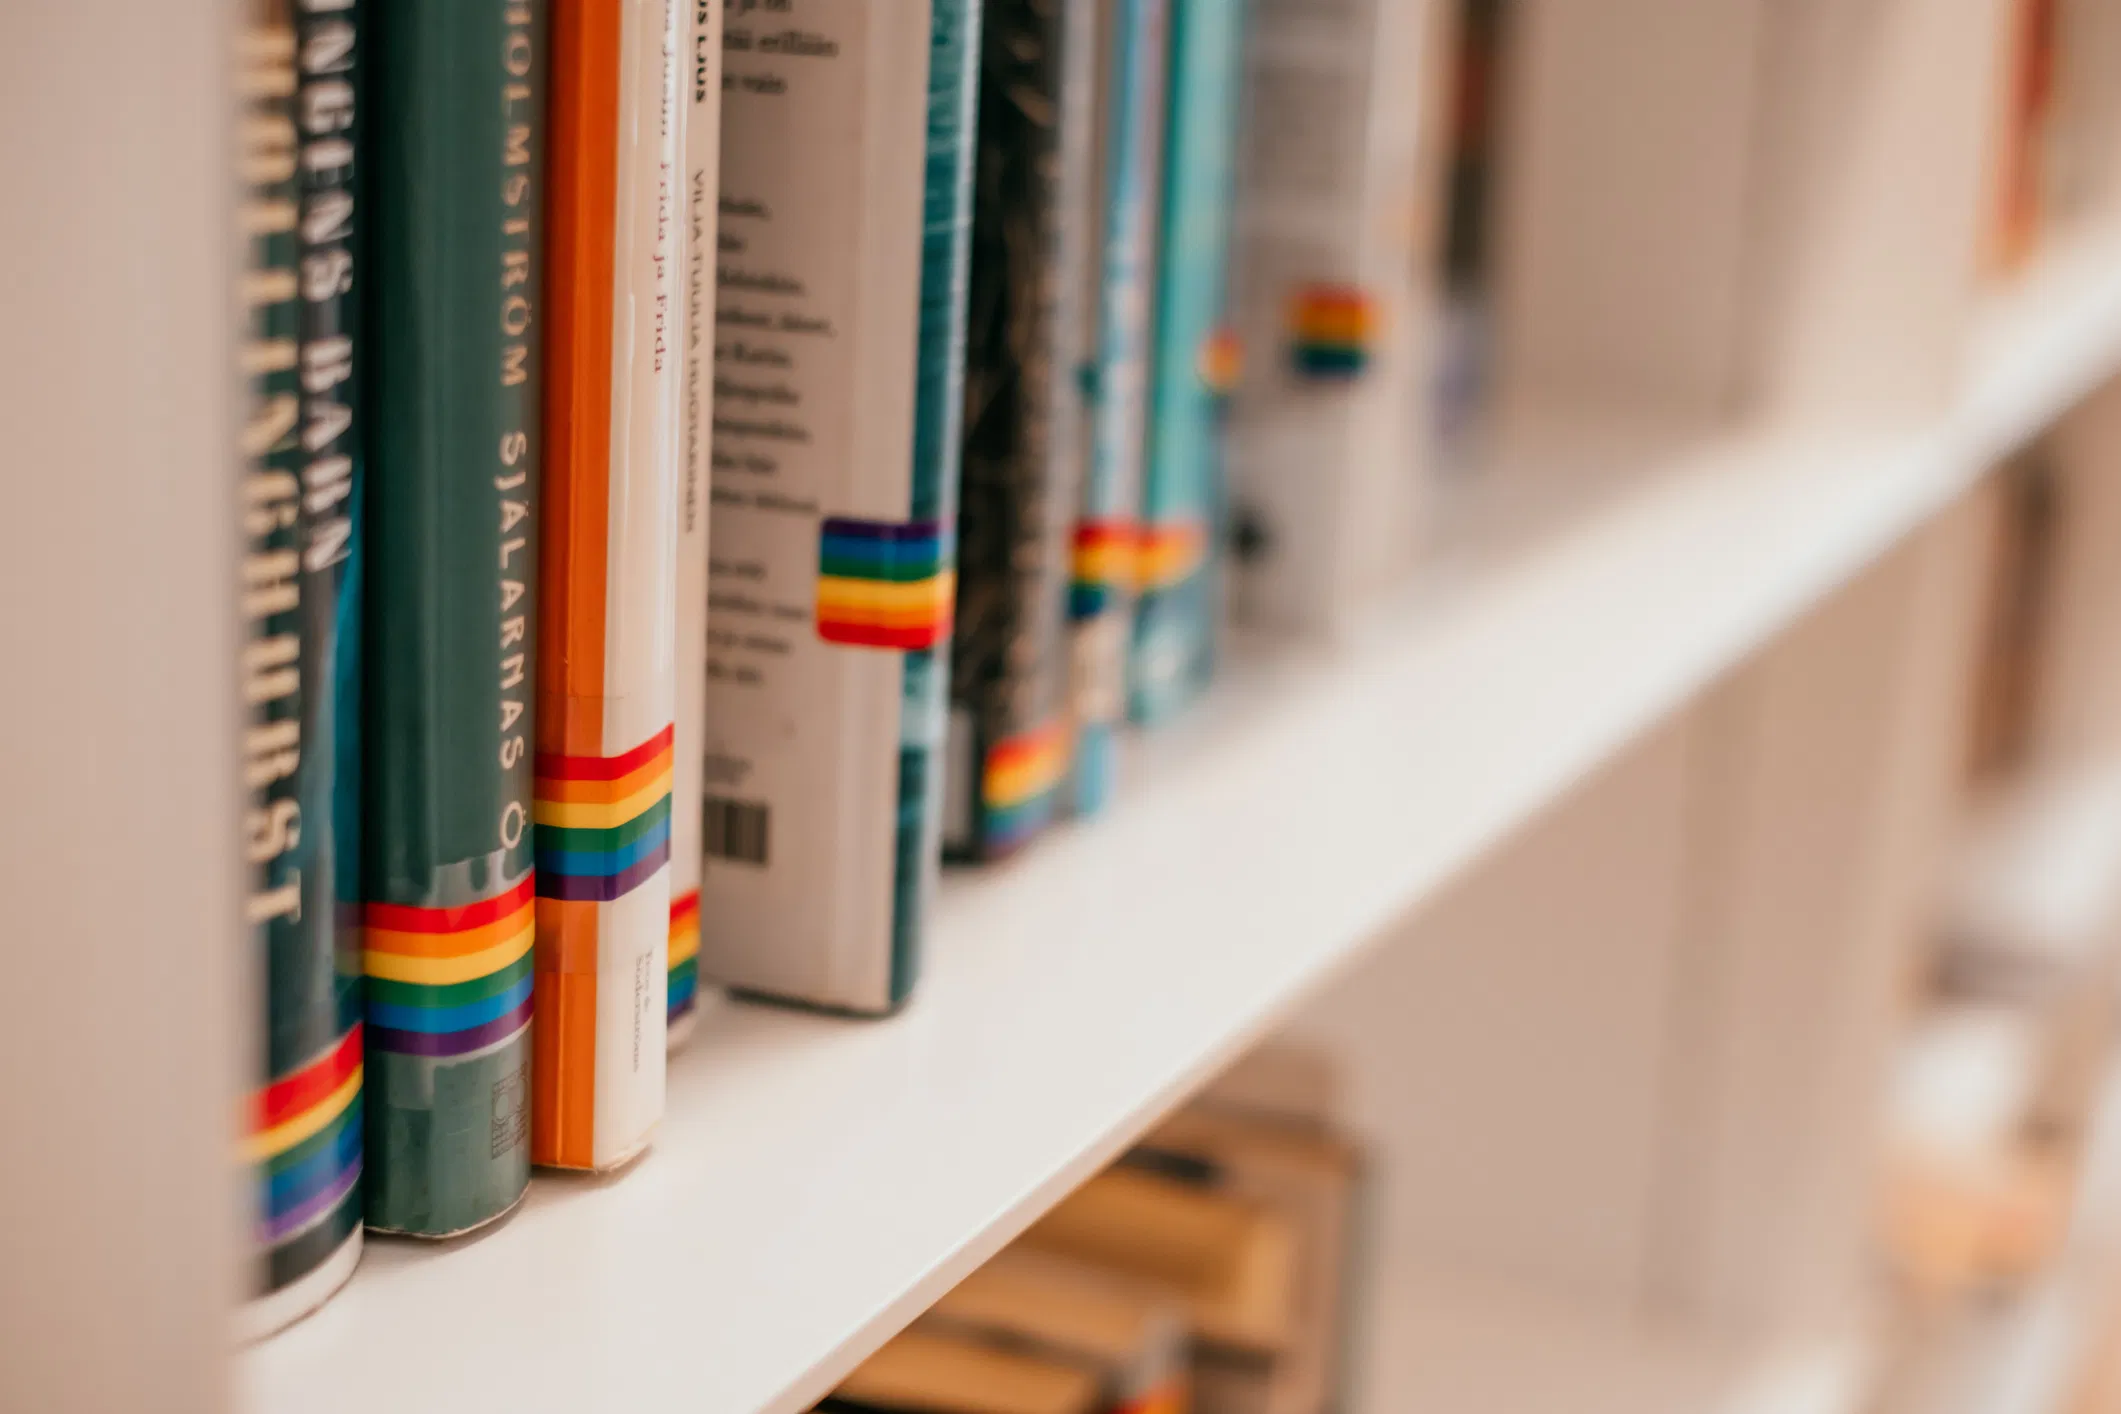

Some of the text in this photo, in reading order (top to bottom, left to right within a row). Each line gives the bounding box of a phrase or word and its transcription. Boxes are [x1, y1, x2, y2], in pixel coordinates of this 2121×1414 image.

[695, 35, 707, 103] LJUS
[658, 161, 672, 241] Frida
[652, 254, 668, 280] ja
[654, 294, 668, 374] Frida
[301, 335, 353, 573] BARN
[494, 431, 529, 770] SJÄLARNAS
